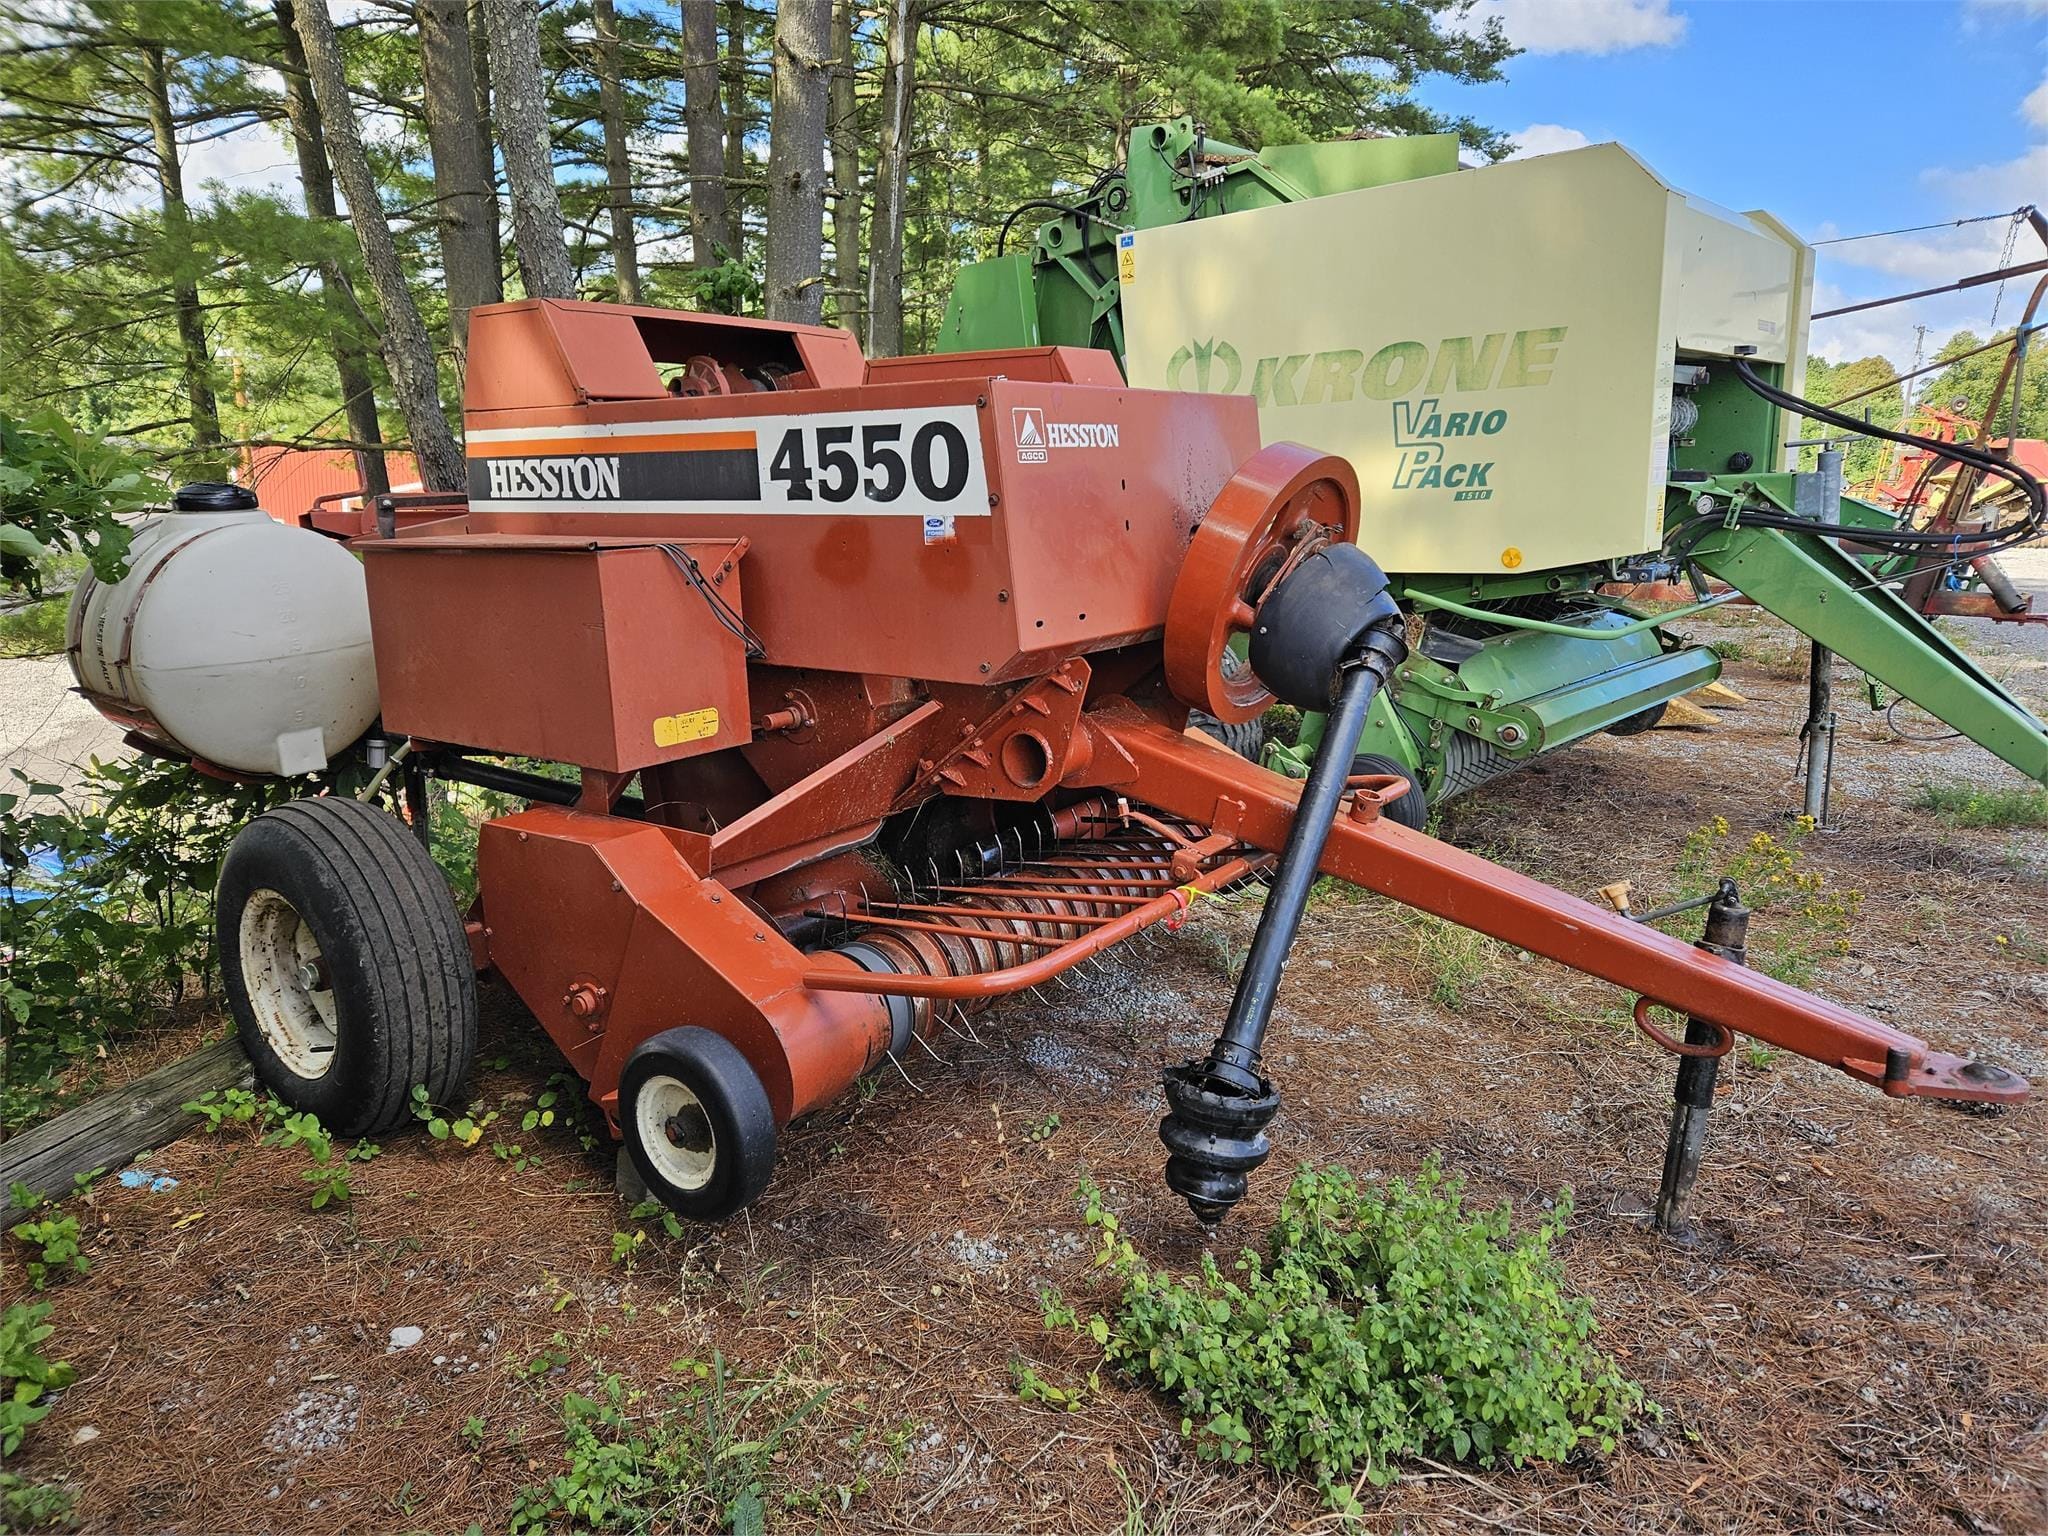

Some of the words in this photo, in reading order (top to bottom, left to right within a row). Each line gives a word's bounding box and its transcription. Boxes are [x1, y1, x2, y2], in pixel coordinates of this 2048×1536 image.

[1251, 326, 1568, 408] KRONE
[1046, 423, 1119, 448] HESSTON
[1392, 398, 1508, 447] VARIO
[487, 456, 621, 500] HESSTON
[769, 420, 970, 503] 4550
[1021, 452, 1045, 460] AGCO
[1392, 442, 1495, 489] PACK
[1461, 491, 1487, 500] 1510
